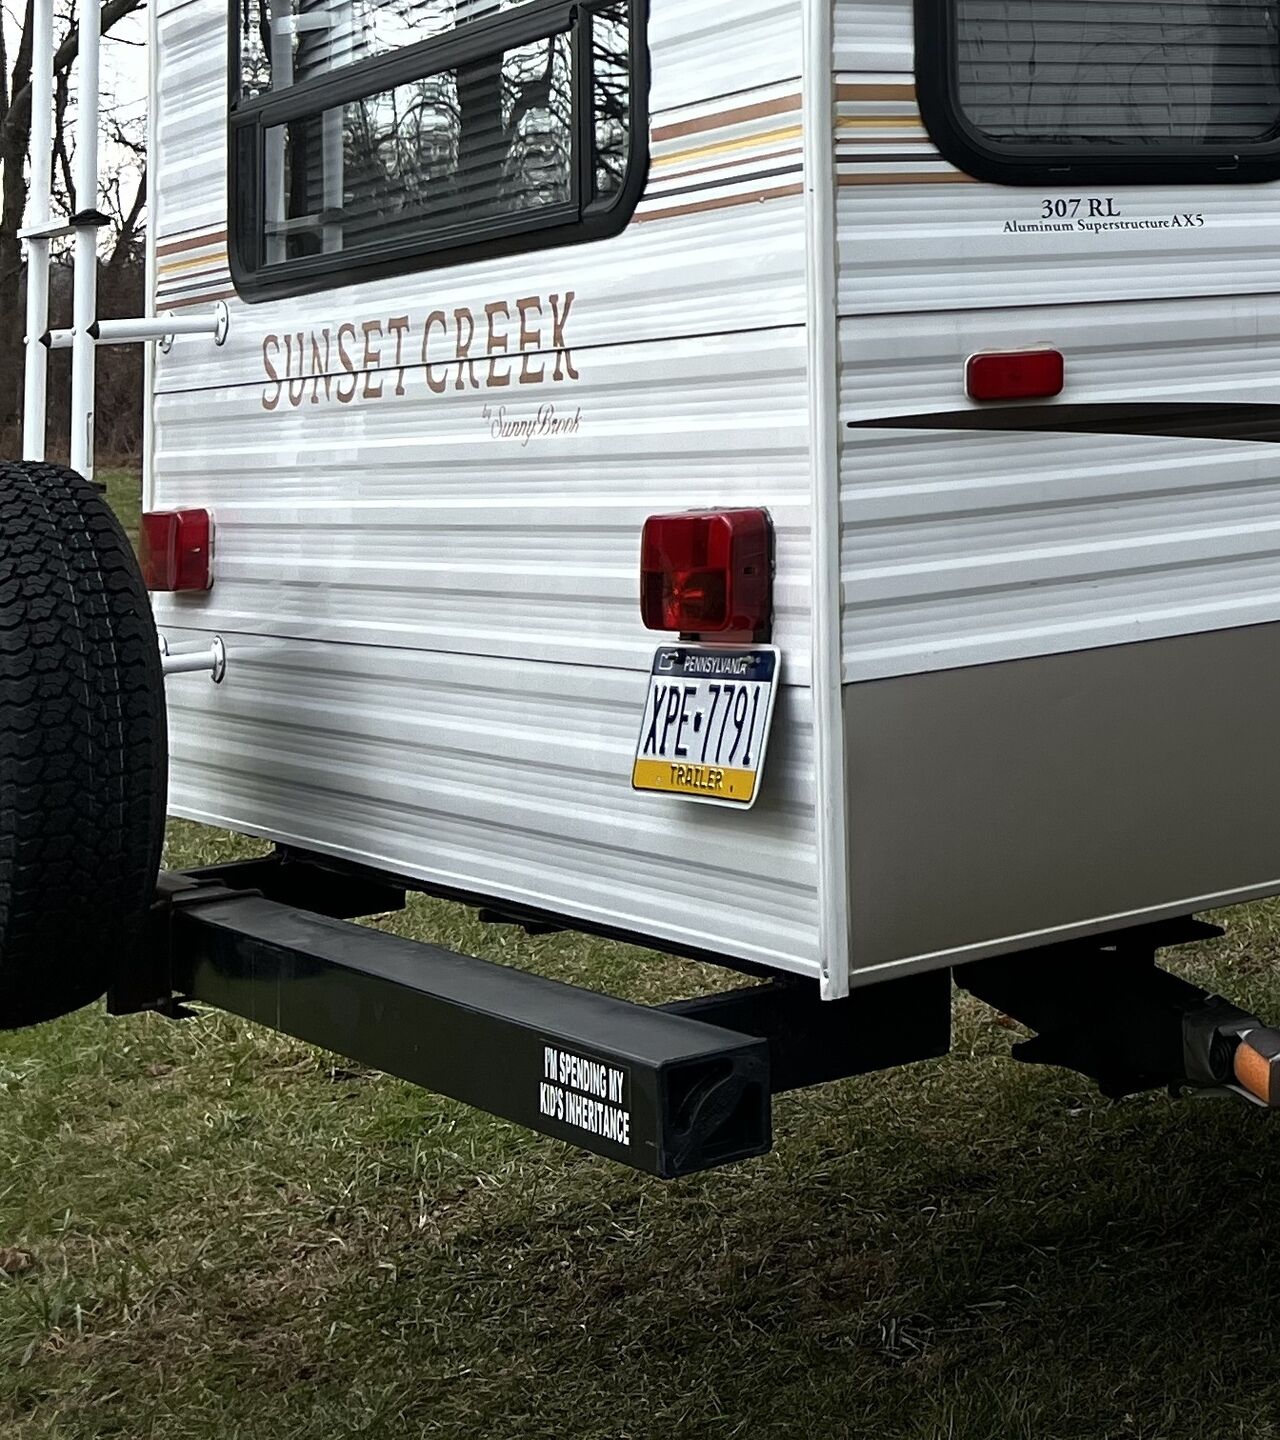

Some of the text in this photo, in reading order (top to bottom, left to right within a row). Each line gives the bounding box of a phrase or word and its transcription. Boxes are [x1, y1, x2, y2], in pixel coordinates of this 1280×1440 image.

[1041, 197, 1121, 219] 307 RL
[1003, 220, 1074, 234] Aluminum
[262, 291, 580, 411] SUNSET CREEK
[684, 656, 746, 674] PENNSYLVANIA
[670, 765, 723, 789] TRAILER
[545, 1047, 624, 1103] I'M SPENDING MY
[539, 1082, 630, 1145] KID'S INHERITANCE
